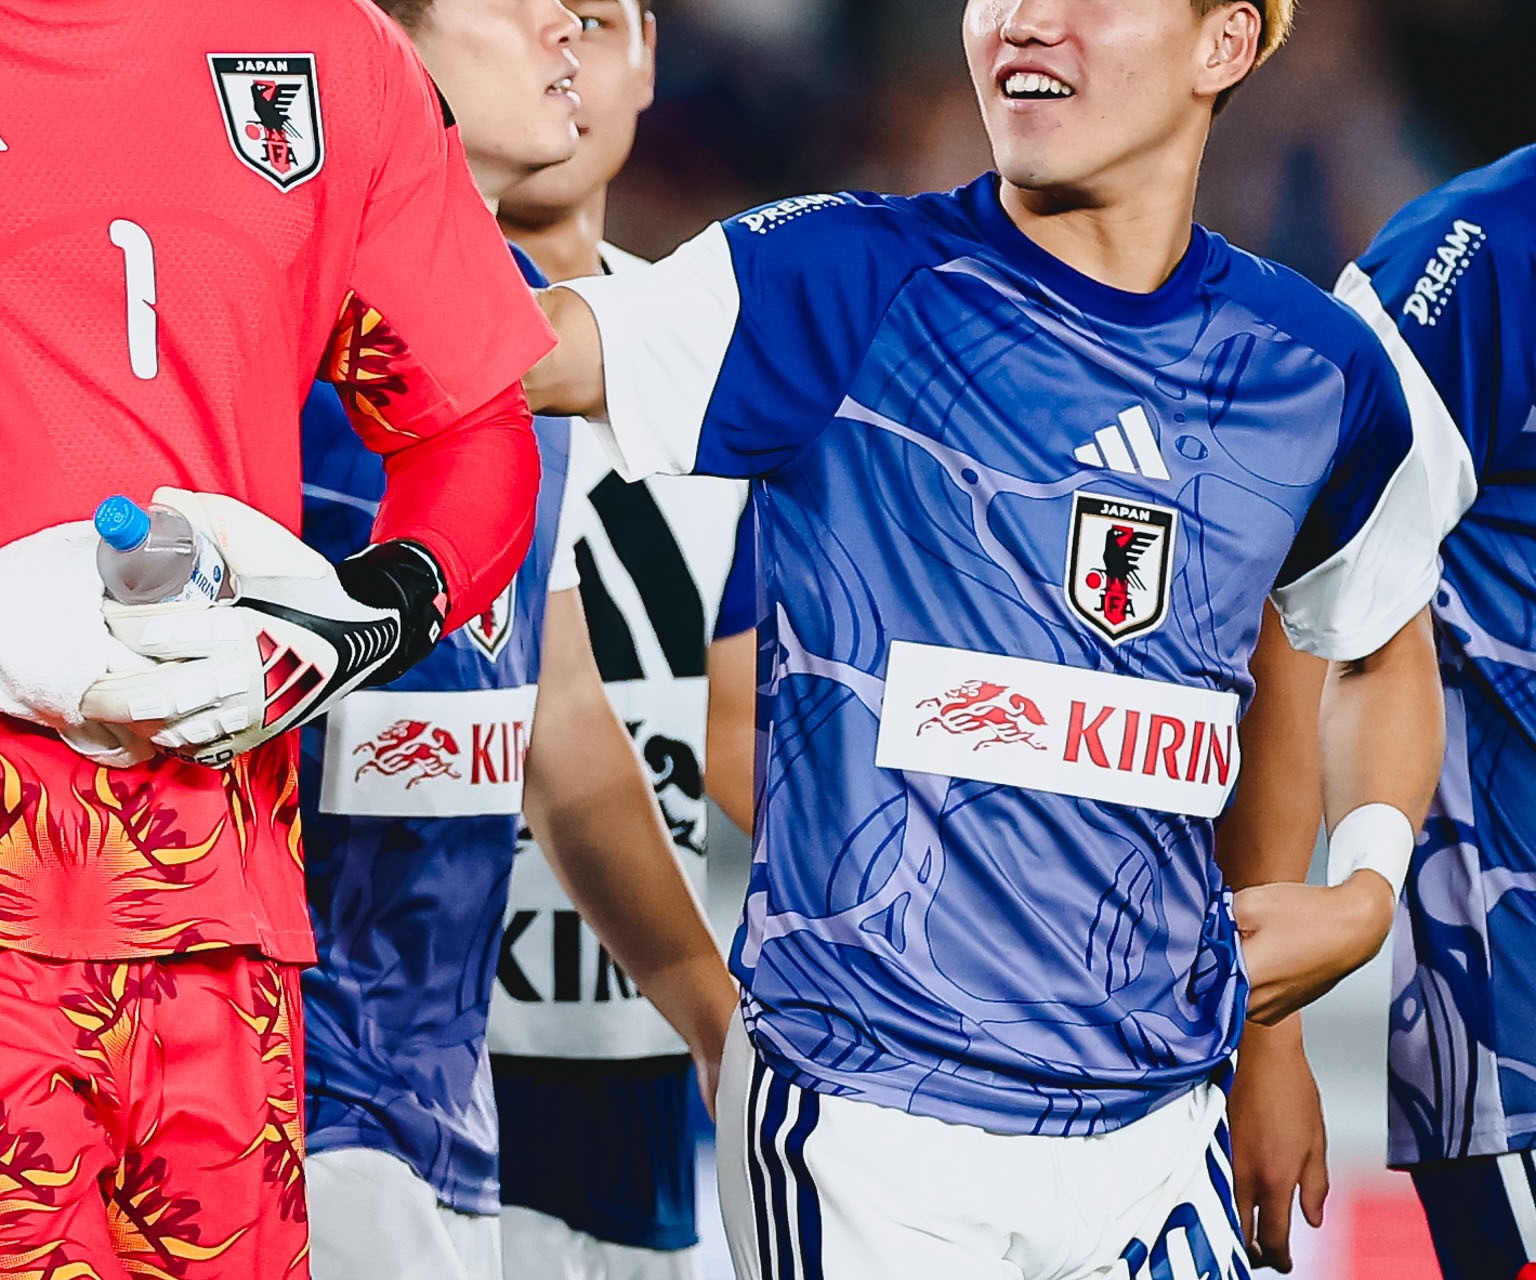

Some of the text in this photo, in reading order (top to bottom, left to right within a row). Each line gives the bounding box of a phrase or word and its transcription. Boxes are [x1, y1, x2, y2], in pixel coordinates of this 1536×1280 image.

[236, 60, 288, 72] JAPAN
[108, 218, 159, 380] 1
[1403, 219, 1482, 325] DREAM
[1100, 504, 1150, 522] JAPAN
[1063, 700, 1233, 786] KIRIN
